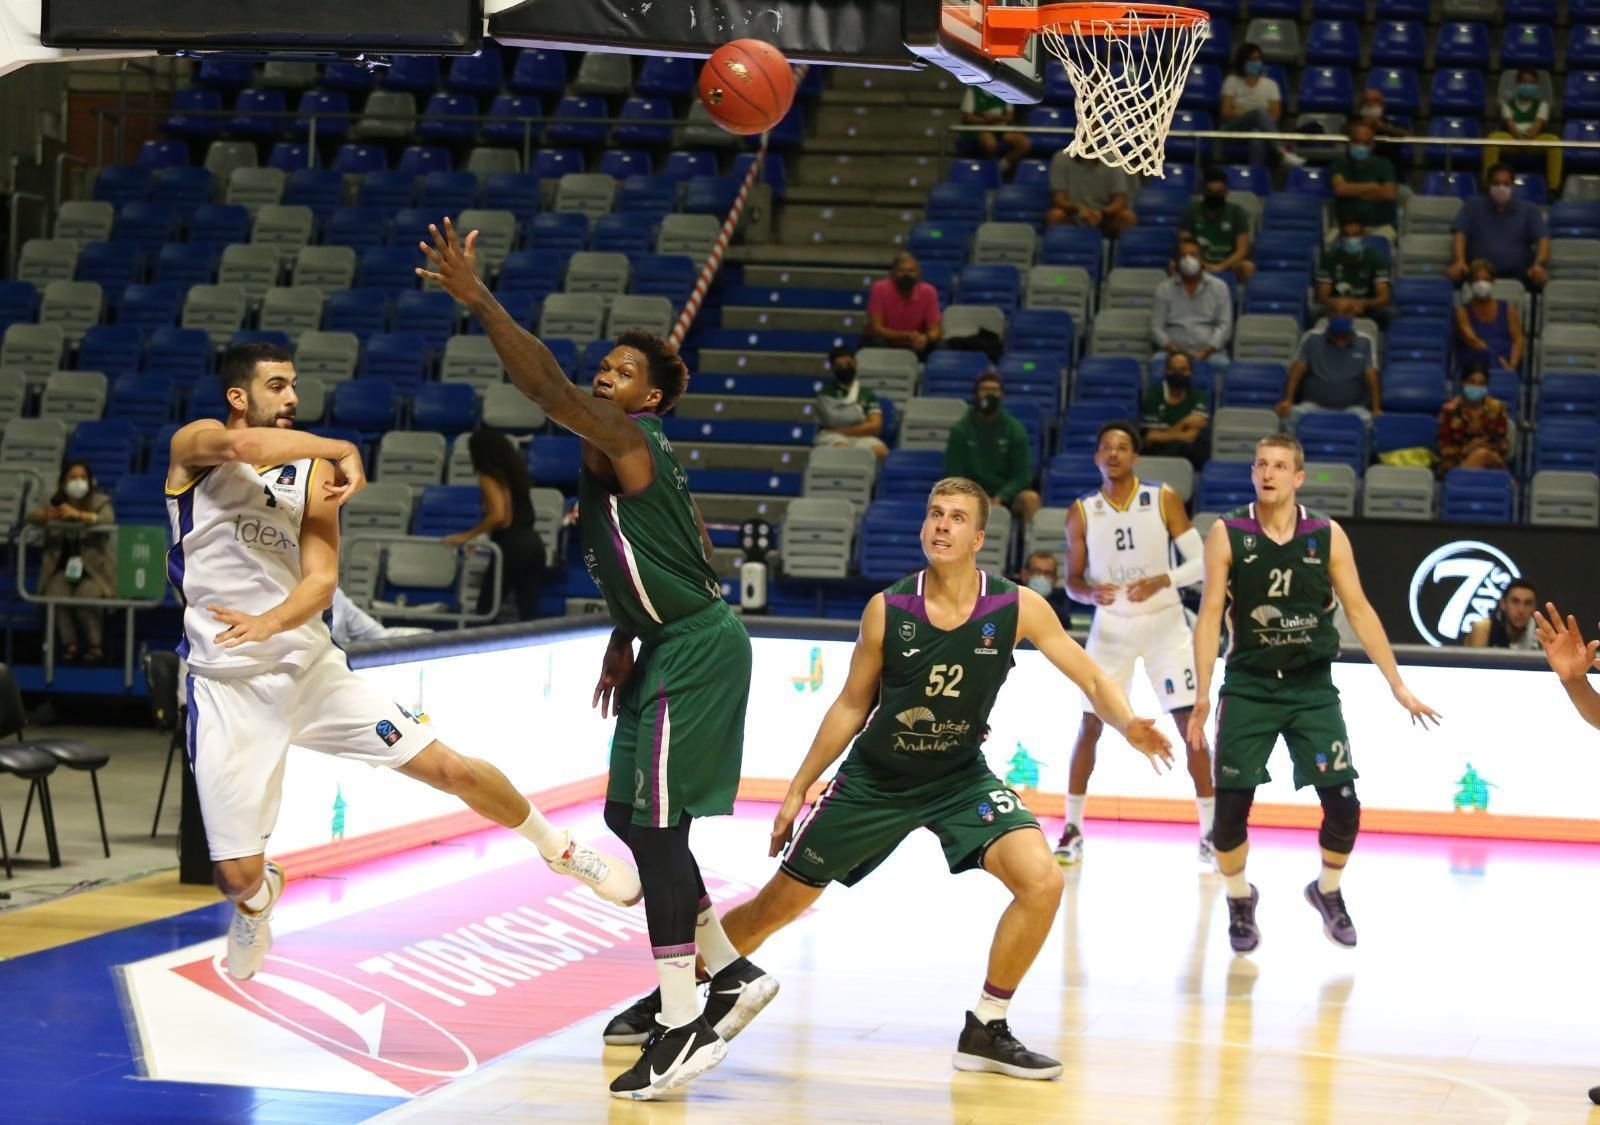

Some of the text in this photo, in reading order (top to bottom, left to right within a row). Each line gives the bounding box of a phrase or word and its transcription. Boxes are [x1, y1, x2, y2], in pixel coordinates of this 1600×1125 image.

[1114, 527, 1135, 551] 21
[1267, 568, 1293, 597] 21
[1433, 558, 1495, 640] 7
[925, 664, 964, 698] 52
[356, 906, 614, 1008] TURKISH
